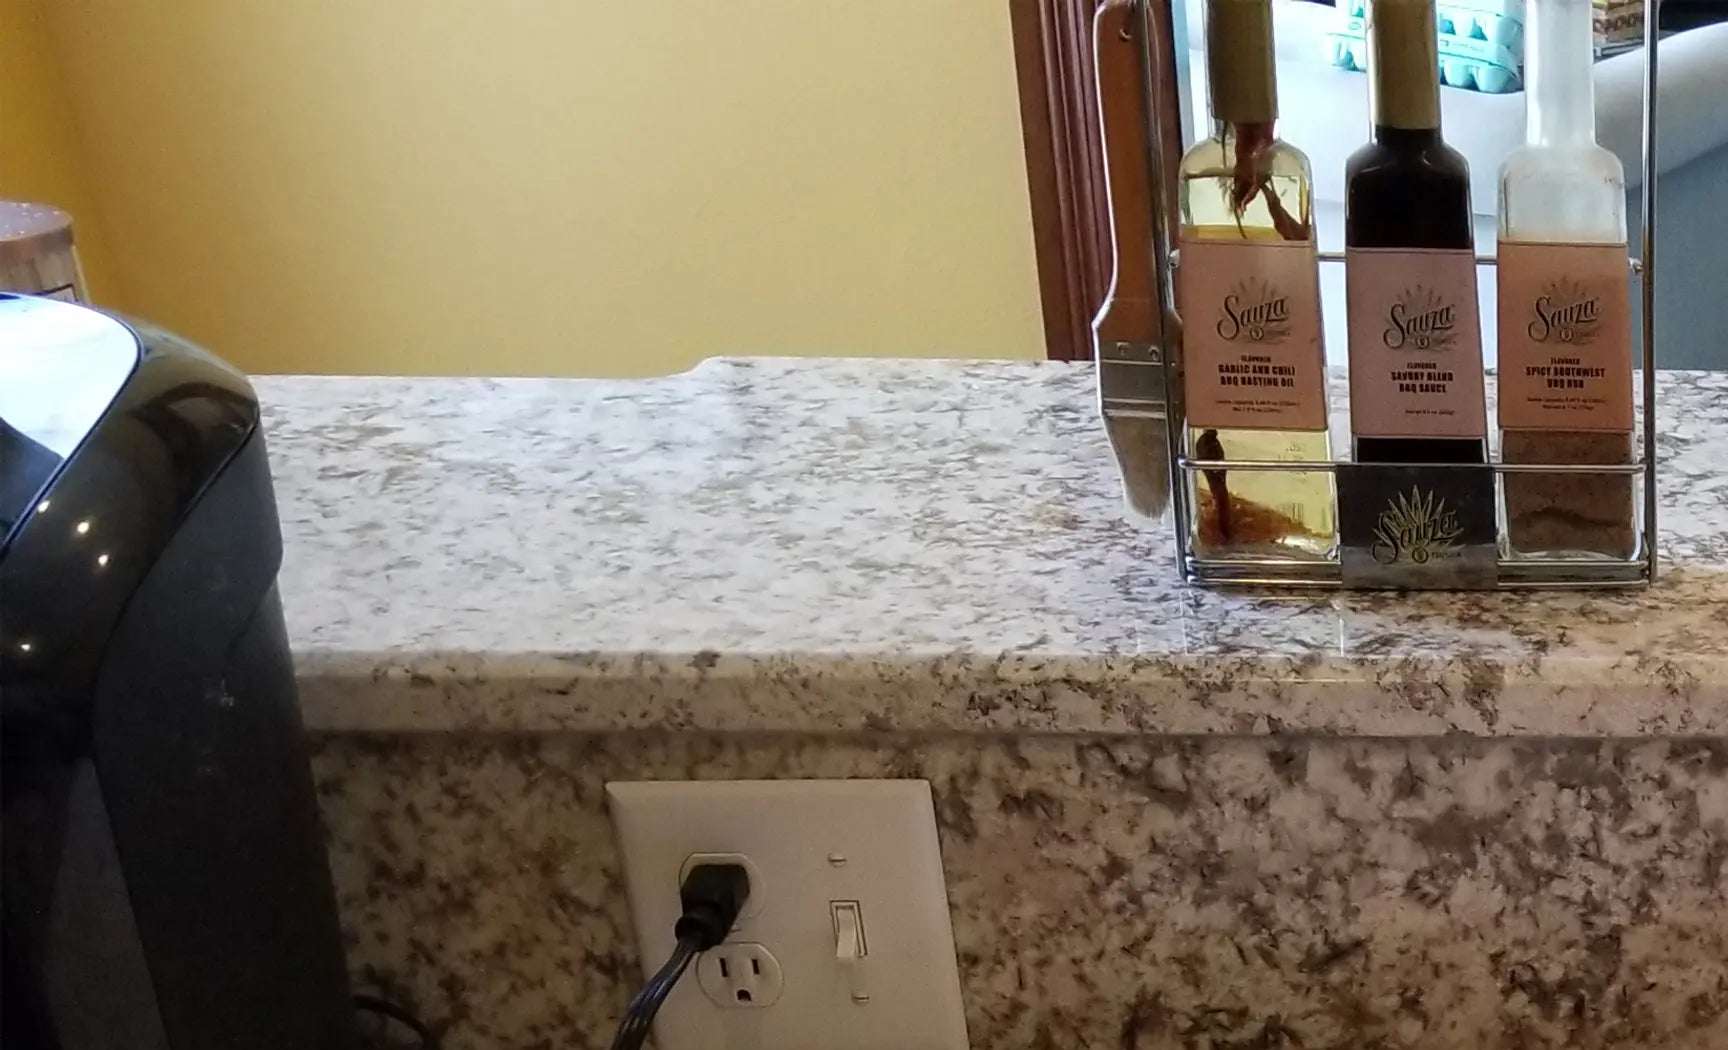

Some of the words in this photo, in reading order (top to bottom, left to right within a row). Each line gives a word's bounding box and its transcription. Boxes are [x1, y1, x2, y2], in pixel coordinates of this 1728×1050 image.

[1217, 294, 1289, 341] Sauza
[1528, 296, 1599, 342] Sauza
[1383, 303, 1455, 349] Sauza
[1218, 364, 1250, 374] GARLIC
[1252, 365, 1270, 375] AND
[1272, 366, 1296, 376] CHILI
[1526, 366, 1551, 376] SPICY
[1553, 367, 1606, 377] SOUTHWEST
[1220, 376, 1239, 387] BBQ
[1241, 376, 1278, 387] BASTING
[1281, 378, 1295, 387] OIL
[1391, 371, 1424, 381] SAVORY
[1426, 372, 1453, 381] BLEND
[1399, 383, 1417, 393] BBQ
[1419, 383, 1447, 393] SAUCE
[1547, 378, 1565, 389] BBQ
[1567, 379, 1584, 388] RUB
[1371, 510, 1461, 565] Sauza
